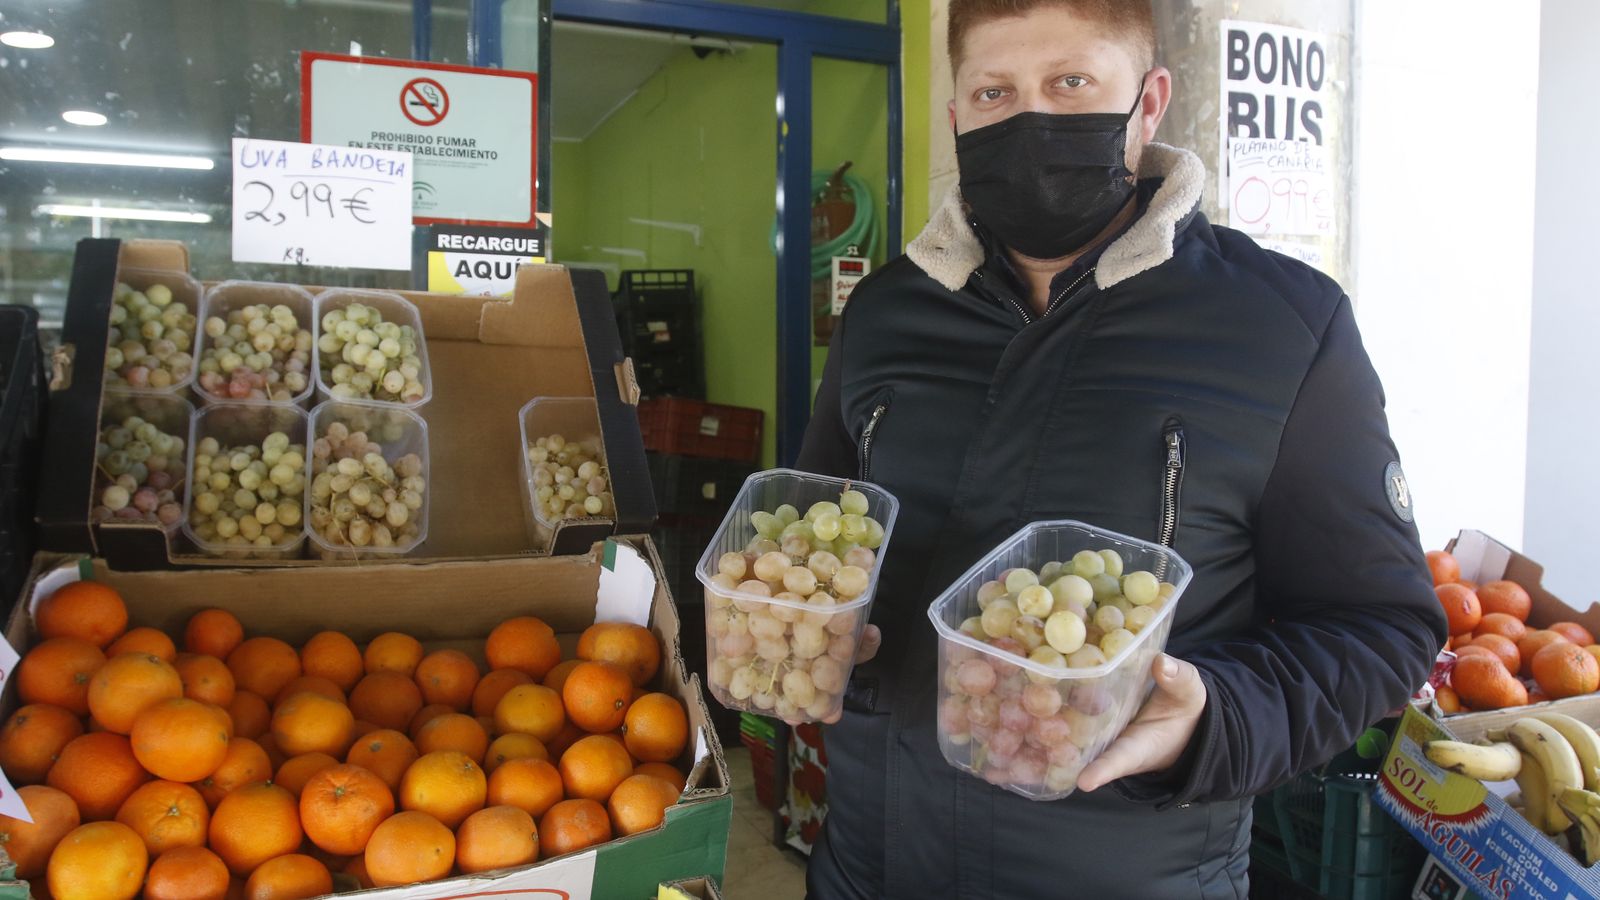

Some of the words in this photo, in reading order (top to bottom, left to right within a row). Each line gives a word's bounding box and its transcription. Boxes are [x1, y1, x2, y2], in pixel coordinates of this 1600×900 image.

[1227, 29, 1325, 92] BONO
[1227, 91, 1323, 146] BUS
[240, 144, 288, 169] UVA
[371, 131, 434, 145] PROHIBIDO
[436, 135, 477, 148] FUMAR
[397, 144, 499, 161] ESTABLECIMIENTO
[437, 233, 540, 253] RECARGUE
[1388, 757, 1426, 801] SOL
[1425, 799, 1439, 812] de
[1485, 837, 1528, 878] ICEBERG
[1500, 826, 1543, 867] VACUUM
[1505, 866, 1548, 900] LETTUC
[1517, 854, 1559, 892] COOLED
